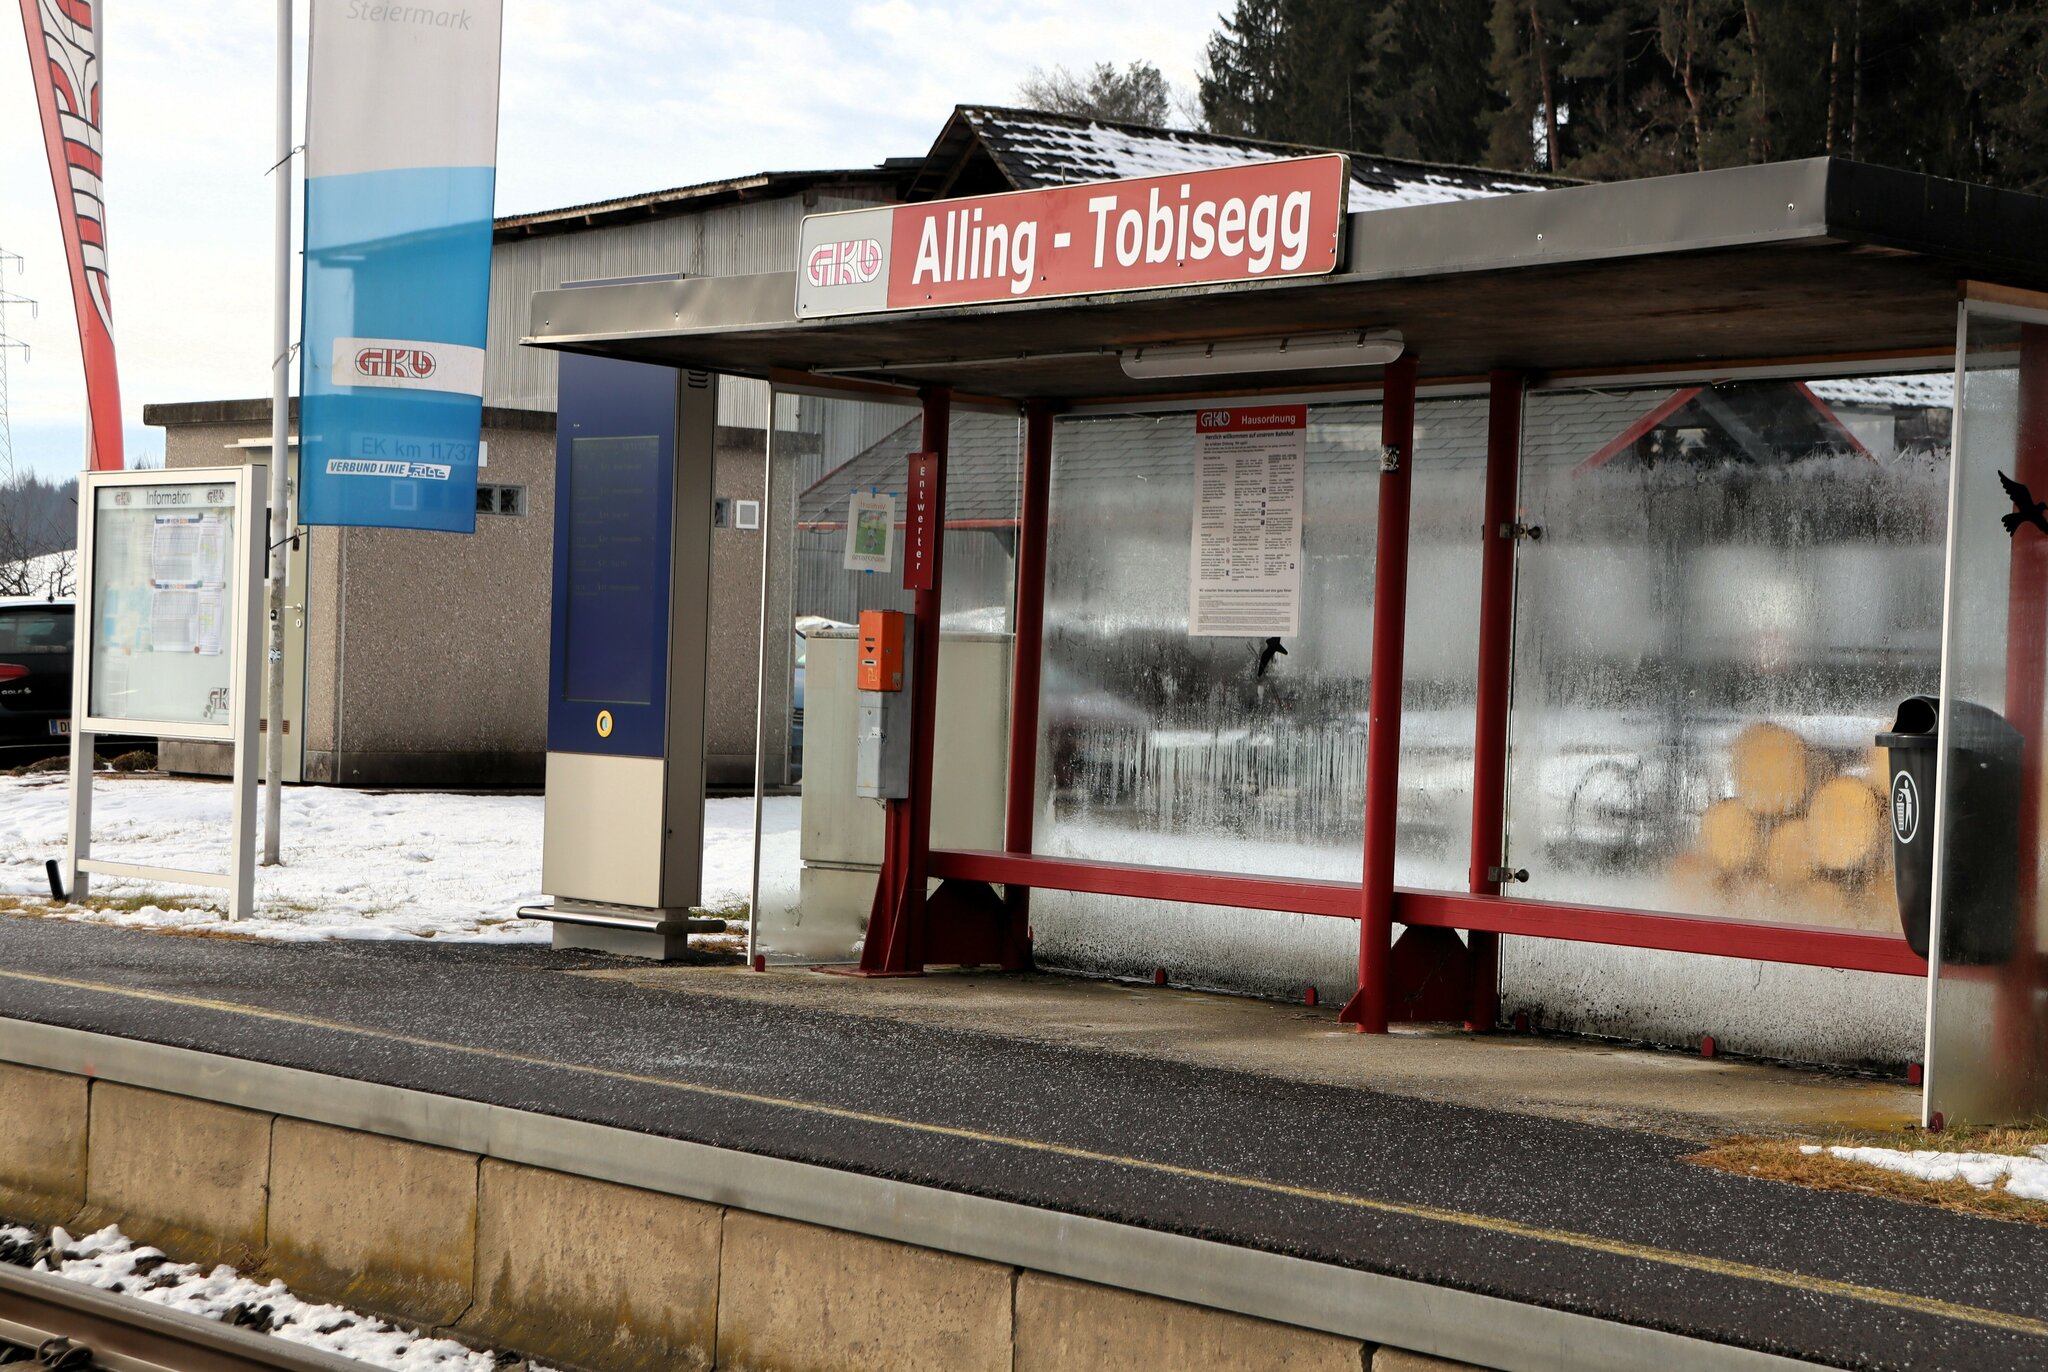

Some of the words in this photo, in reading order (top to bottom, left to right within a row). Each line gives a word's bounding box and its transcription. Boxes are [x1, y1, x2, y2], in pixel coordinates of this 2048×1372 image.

[346, 0, 472, 31] Steiermark
[911, 207, 1037, 295] Alling
[1088, 183, 1312, 274] Tobisegg
[1241, 414, 1296, 425] Hausordnung
[362, 437, 388, 455] EK
[395, 440, 420, 458] km
[430, 442, 475, 462] 11,737
[330, 461, 377, 473] VERBUND
[379, 463, 406, 475] LINIE
[146, 489, 192, 505] Information
[916, 466, 925, 570] Entwerter
